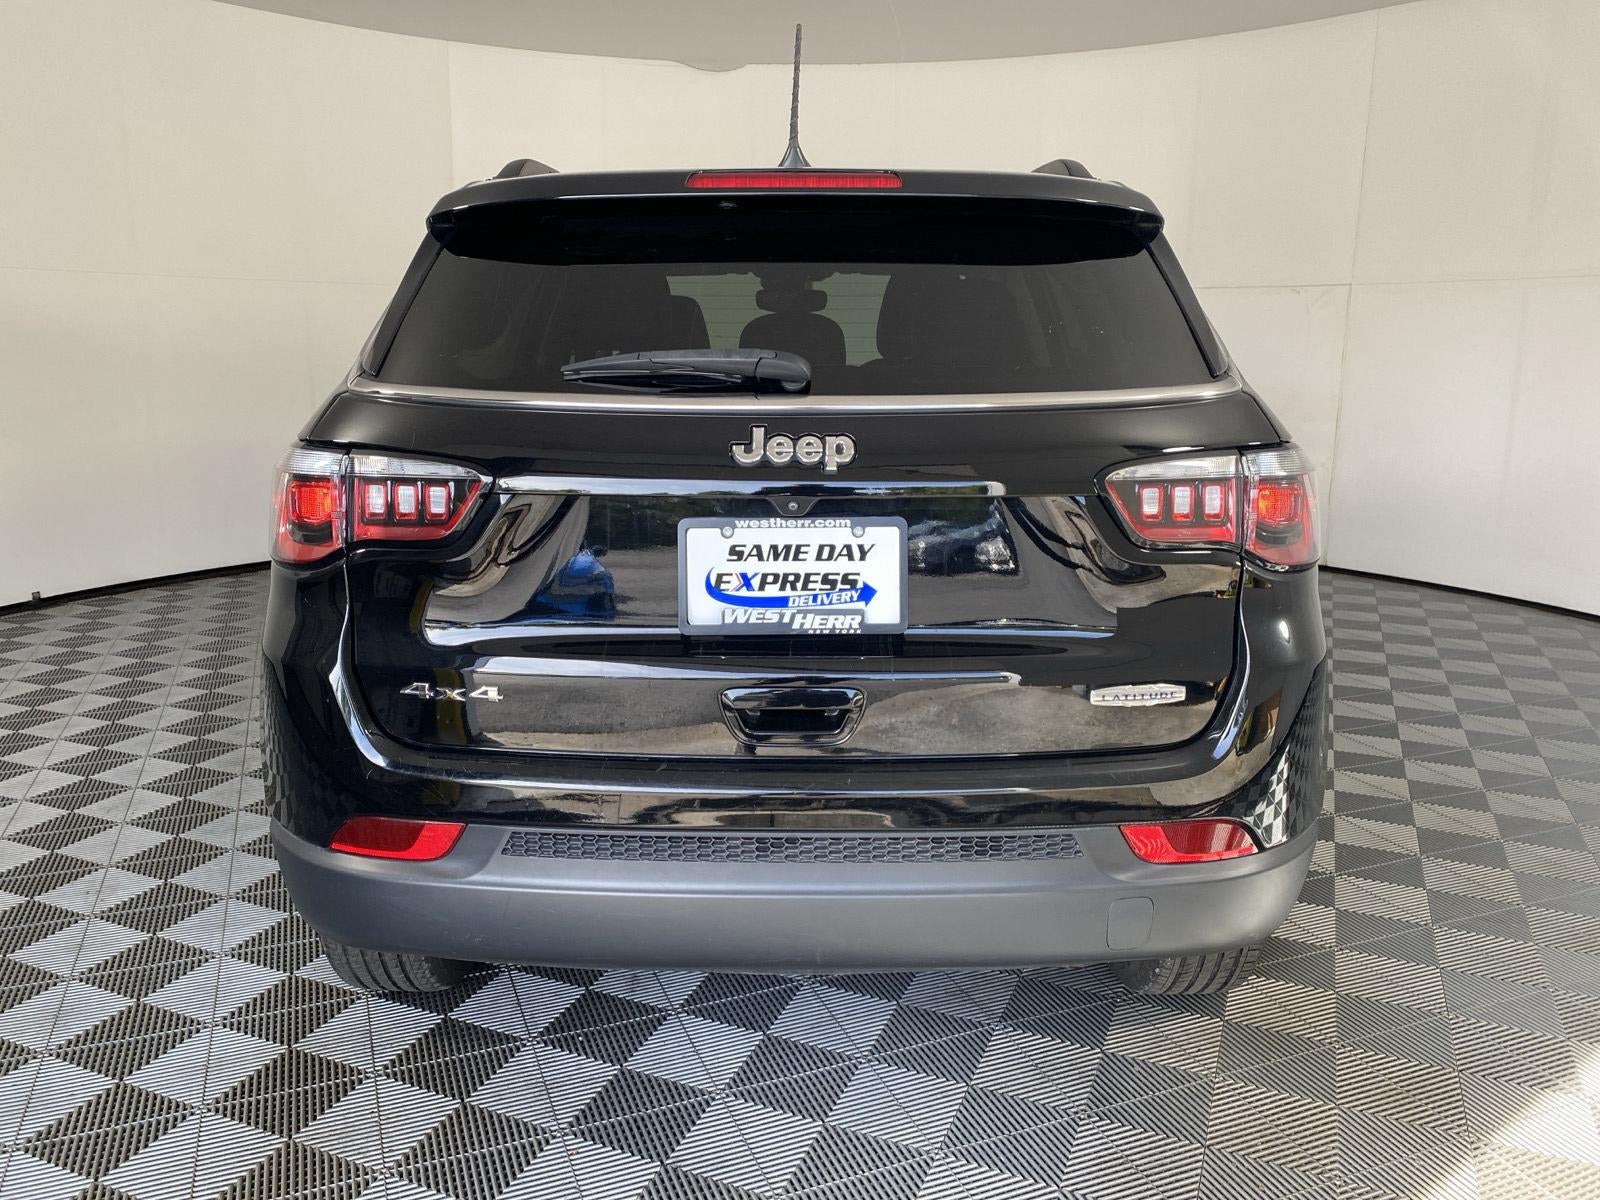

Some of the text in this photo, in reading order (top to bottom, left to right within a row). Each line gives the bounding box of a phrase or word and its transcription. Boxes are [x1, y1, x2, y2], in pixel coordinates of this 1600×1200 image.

[731, 425, 856, 473] Jeep
[735, 517, 851, 529] westherr.com
[726, 543, 876, 562] SAME DAY
[713, 572, 861, 592] EXPRESS
[787, 589, 862, 608] DELIVERY
[399, 682, 504, 702] 4x4
[1099, 690, 1179, 702] LATITUDE
